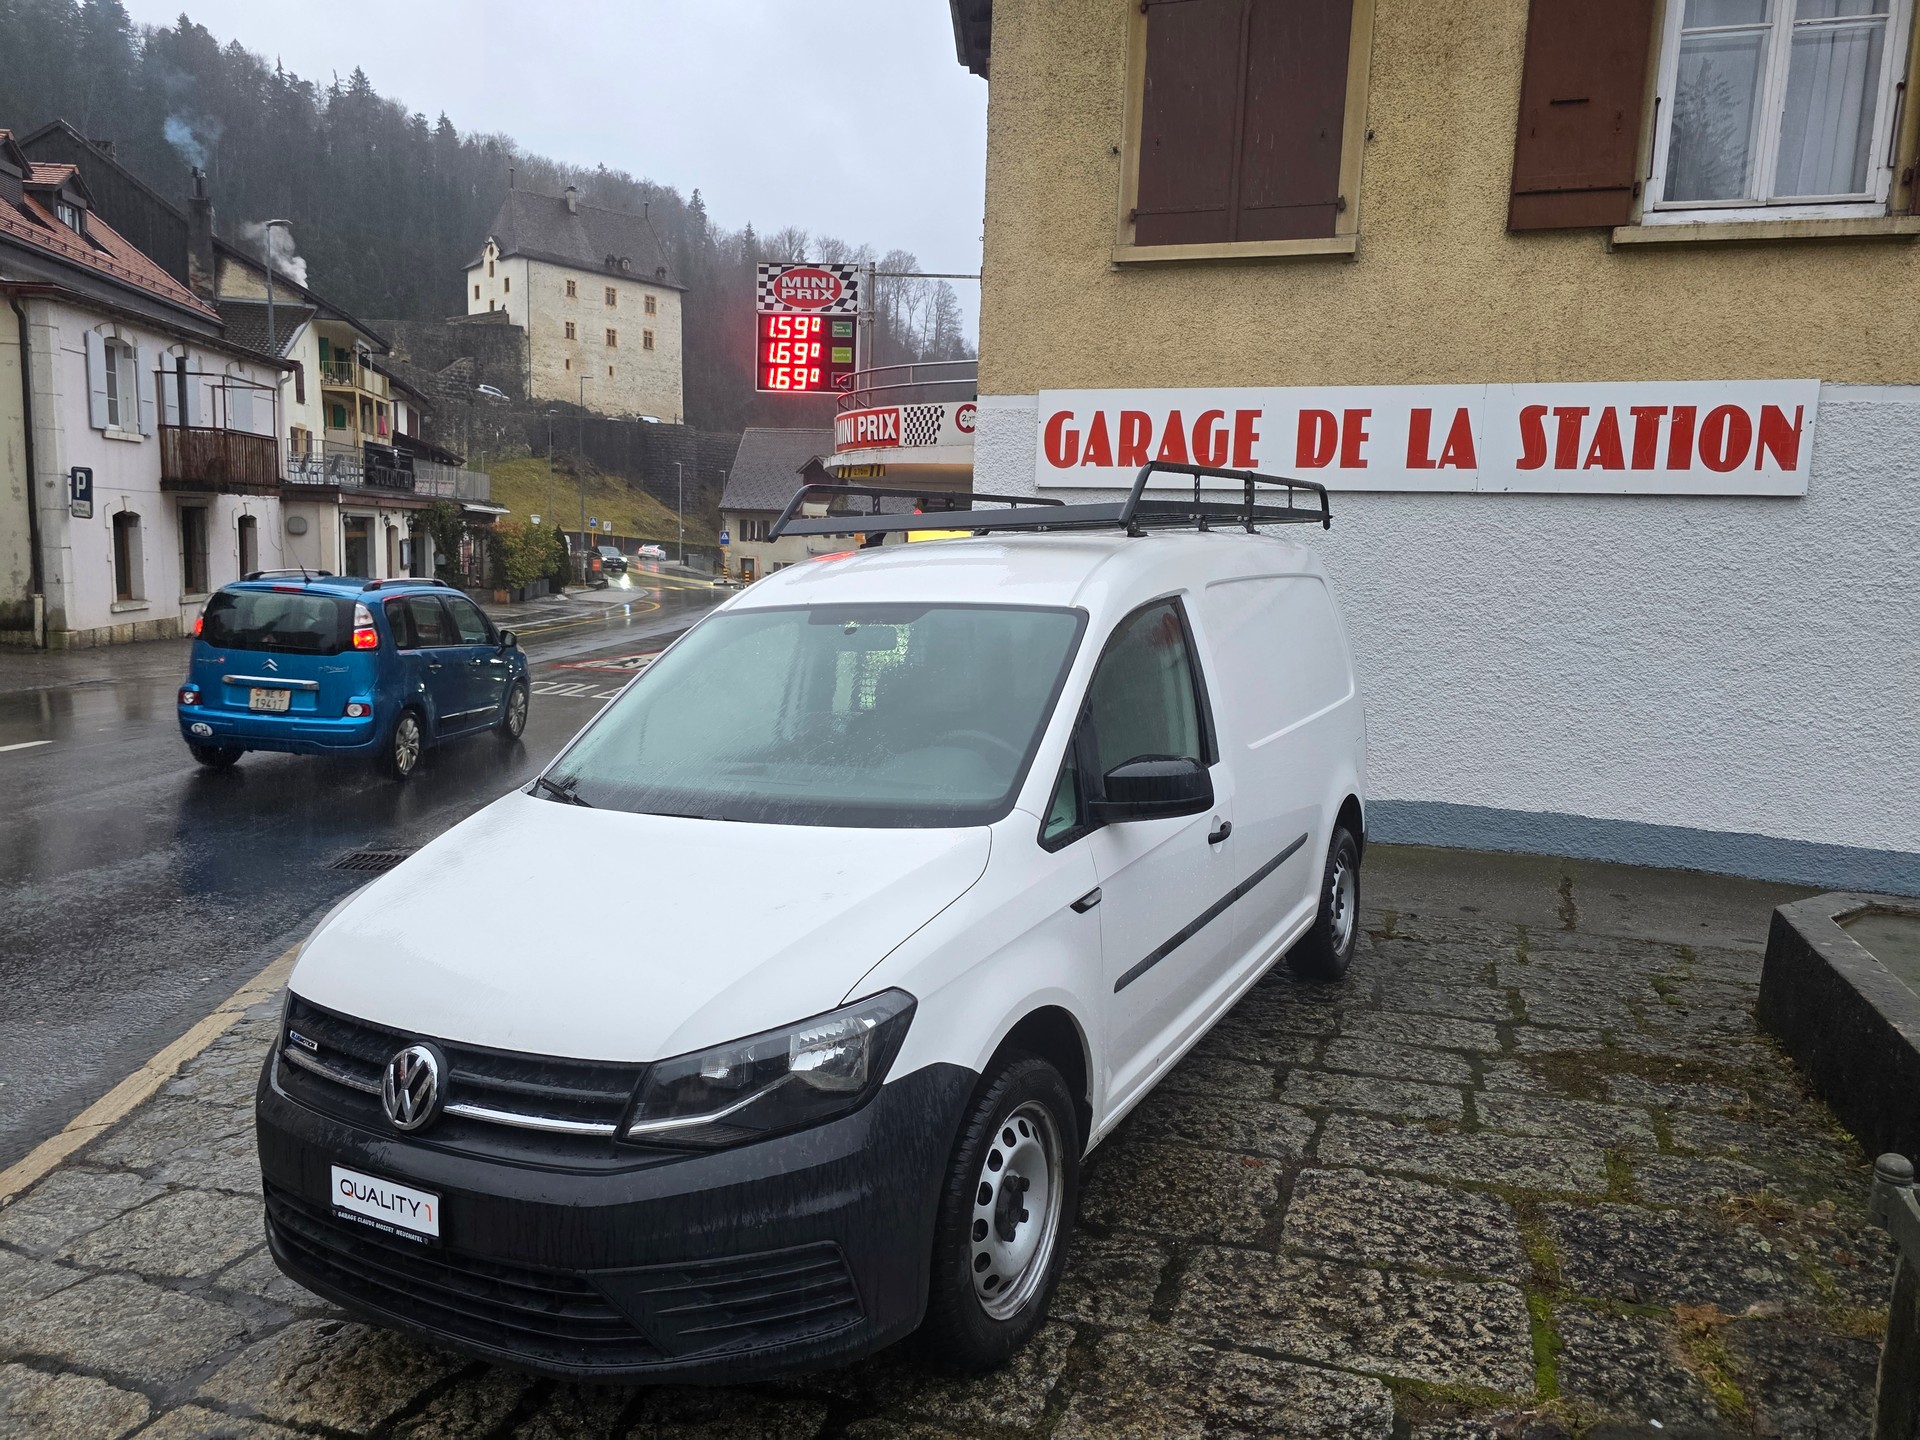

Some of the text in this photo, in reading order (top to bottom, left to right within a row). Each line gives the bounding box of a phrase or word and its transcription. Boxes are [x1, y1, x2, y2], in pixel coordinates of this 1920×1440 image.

[781, 276, 835, 288] MINI
[781, 288, 835, 300] PRIX
[836, 413, 897, 445] MINI PRIX
[1044, 404, 1804, 473] GARAGE DE LA STATION
[76, 471, 87, 498] P
[340, 1178, 432, 1222] QUALITY 1
[337, 1211, 357, 1222] GARAGE
[357, 1216, 375, 1228] CLAUDE
